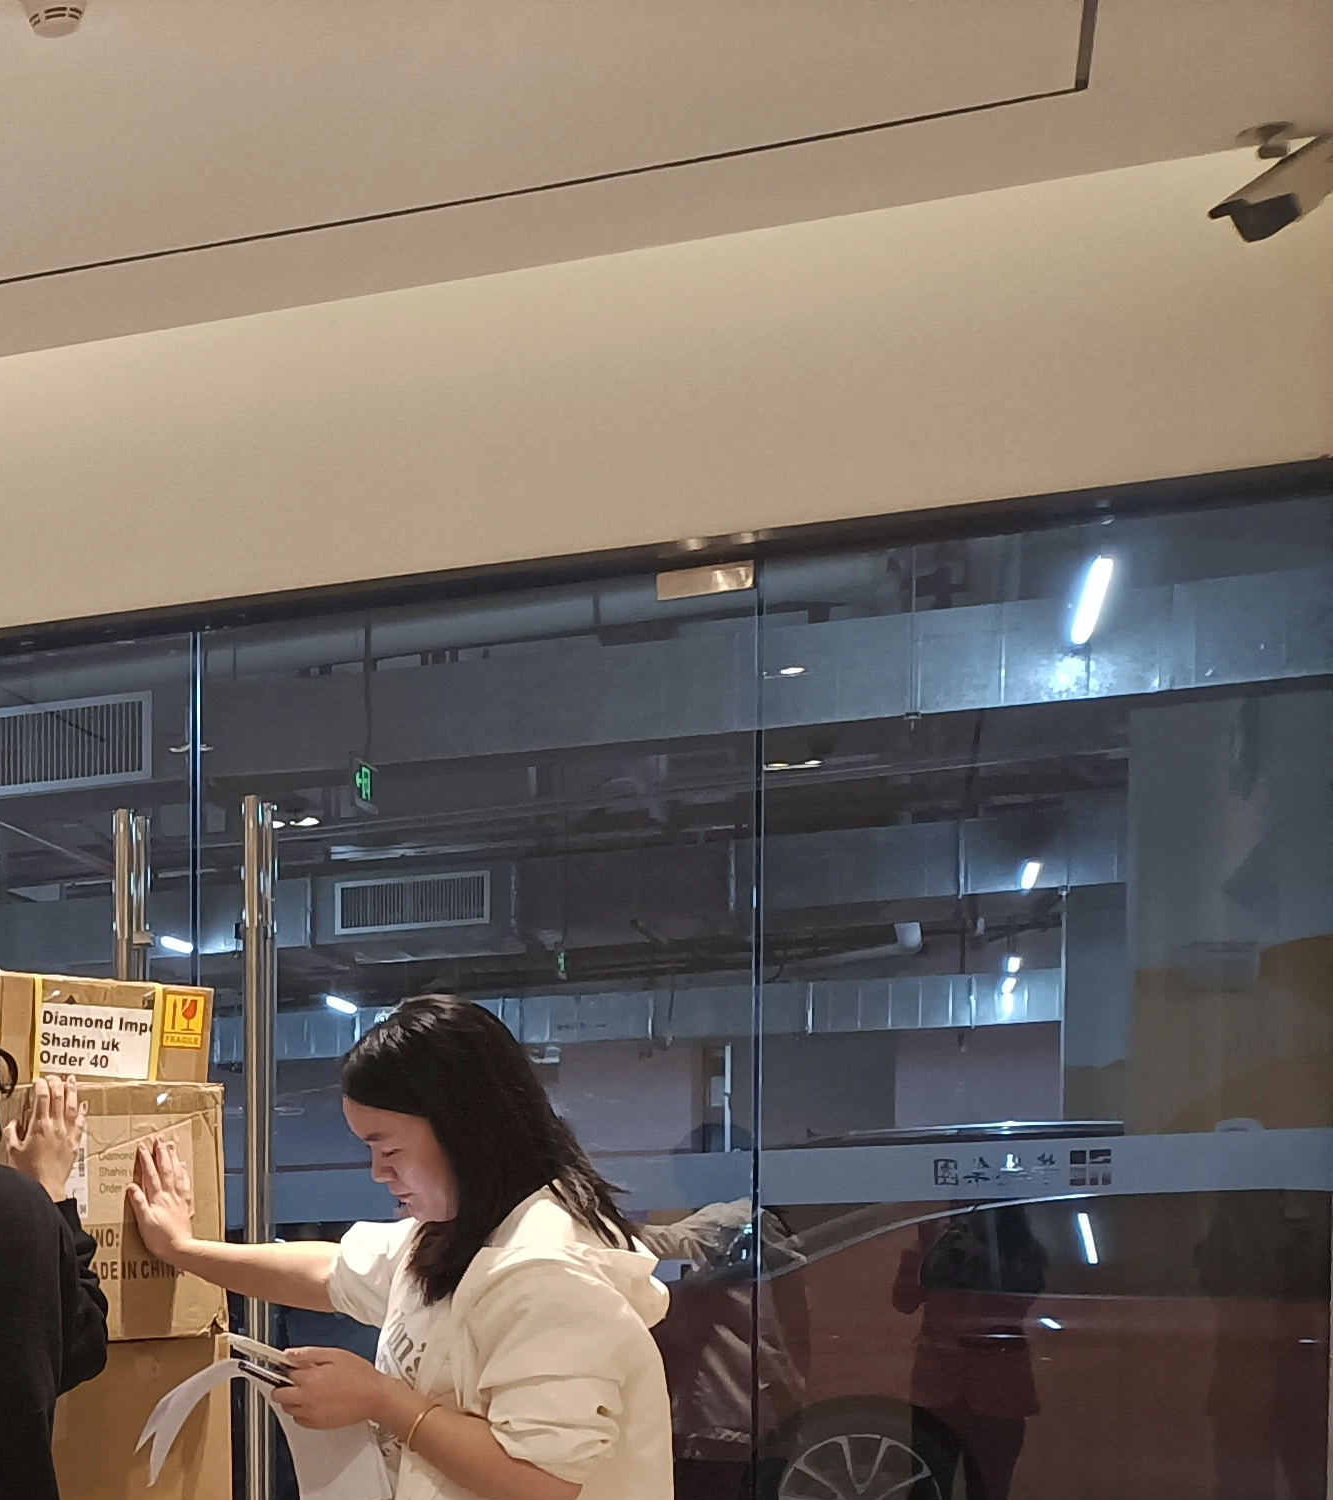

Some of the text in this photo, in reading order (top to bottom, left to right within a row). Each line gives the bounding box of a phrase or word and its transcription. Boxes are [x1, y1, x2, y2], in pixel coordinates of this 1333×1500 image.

[42, 1010, 114, 1031] Diamond
[40, 1032, 120, 1052] Shahin uk
[164, 1036, 199, 1046] FRAGILE
[39, 1051, 109, 1069] Order 40
[98, 1183, 123, 1194] Order
[92, 1261, 119, 1280] ADE
[121, 1260, 137, 1280] IN
